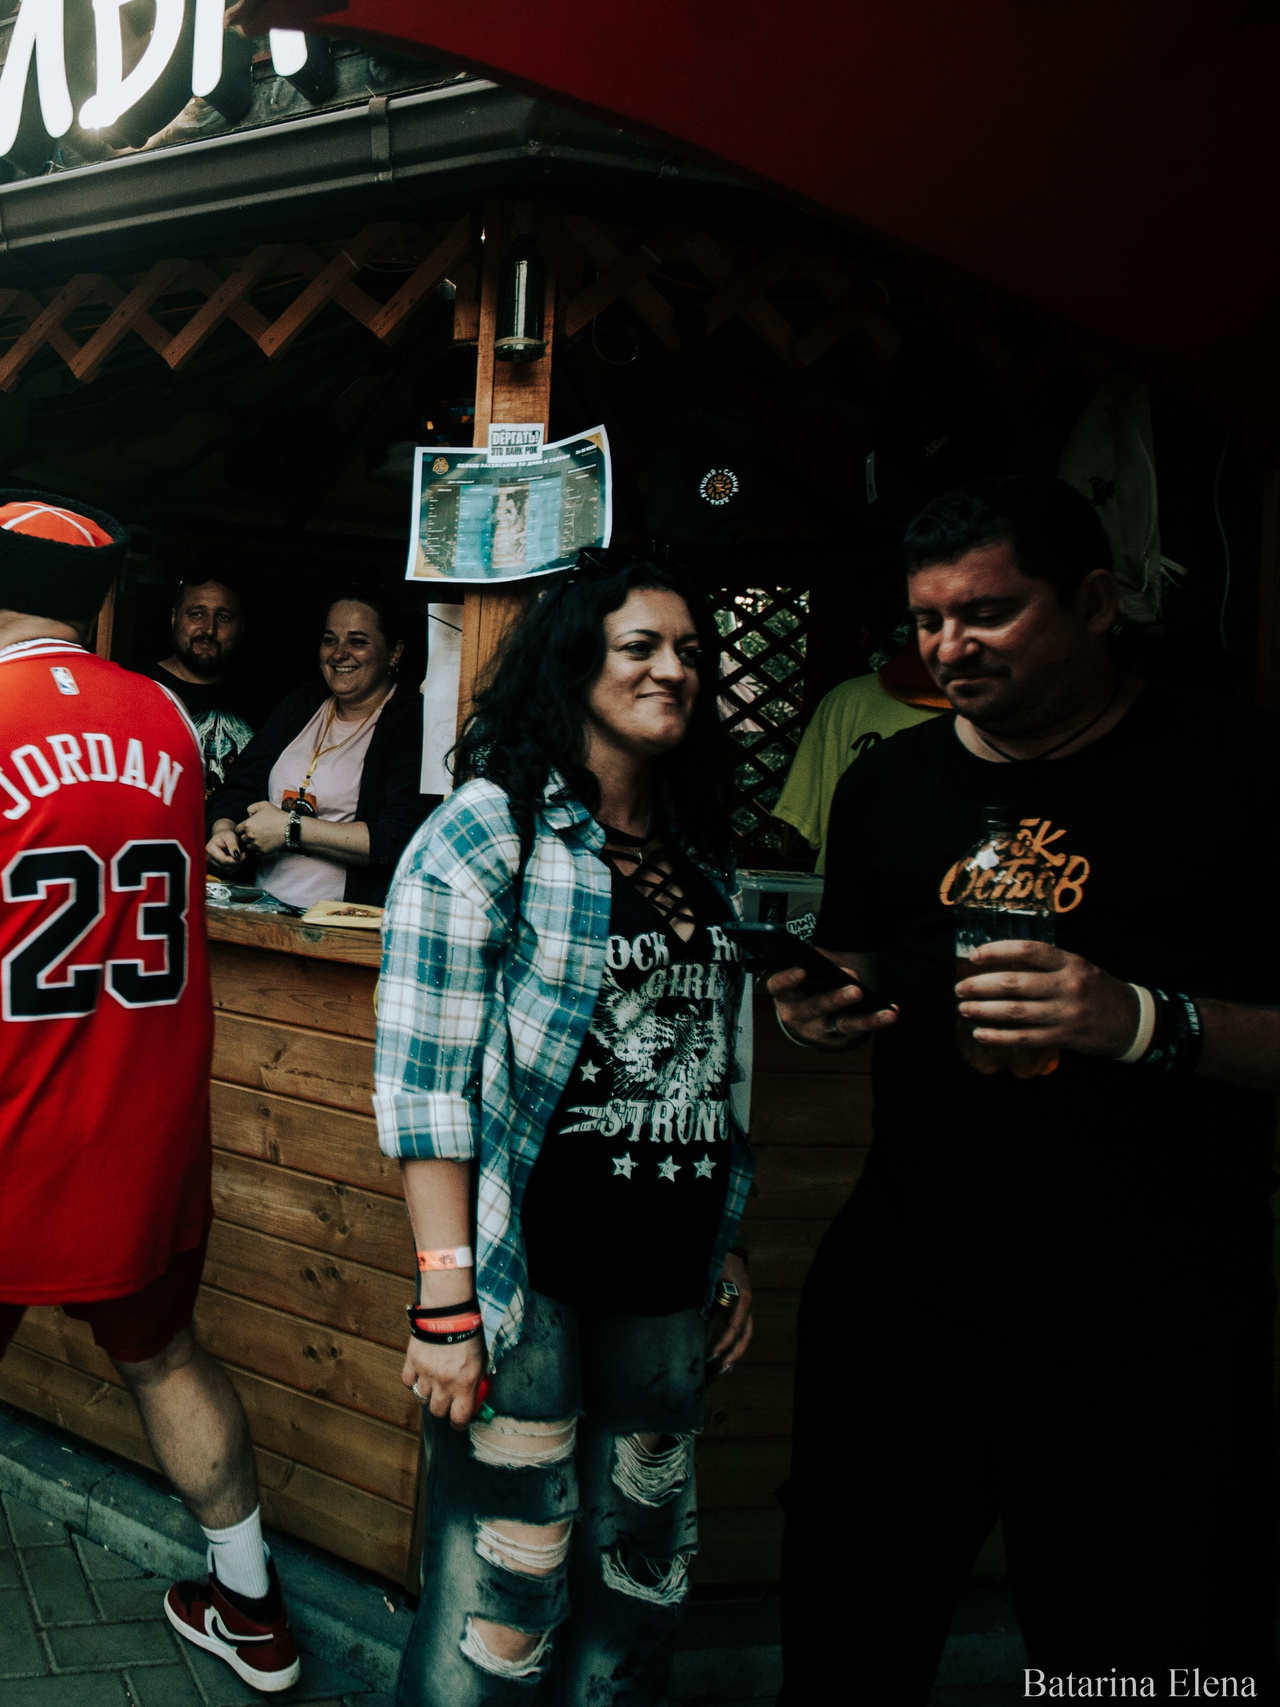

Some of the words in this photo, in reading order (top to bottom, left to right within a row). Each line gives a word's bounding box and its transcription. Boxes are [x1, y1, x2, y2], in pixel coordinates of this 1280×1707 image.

[491, 447, 504, 456] ЭТО
[506, 447, 524, 456] ПАНК
[525, 446, 539, 455] РОК
[1, 839, 192, 1022] 23
[606, 931, 670, 971] OCK
